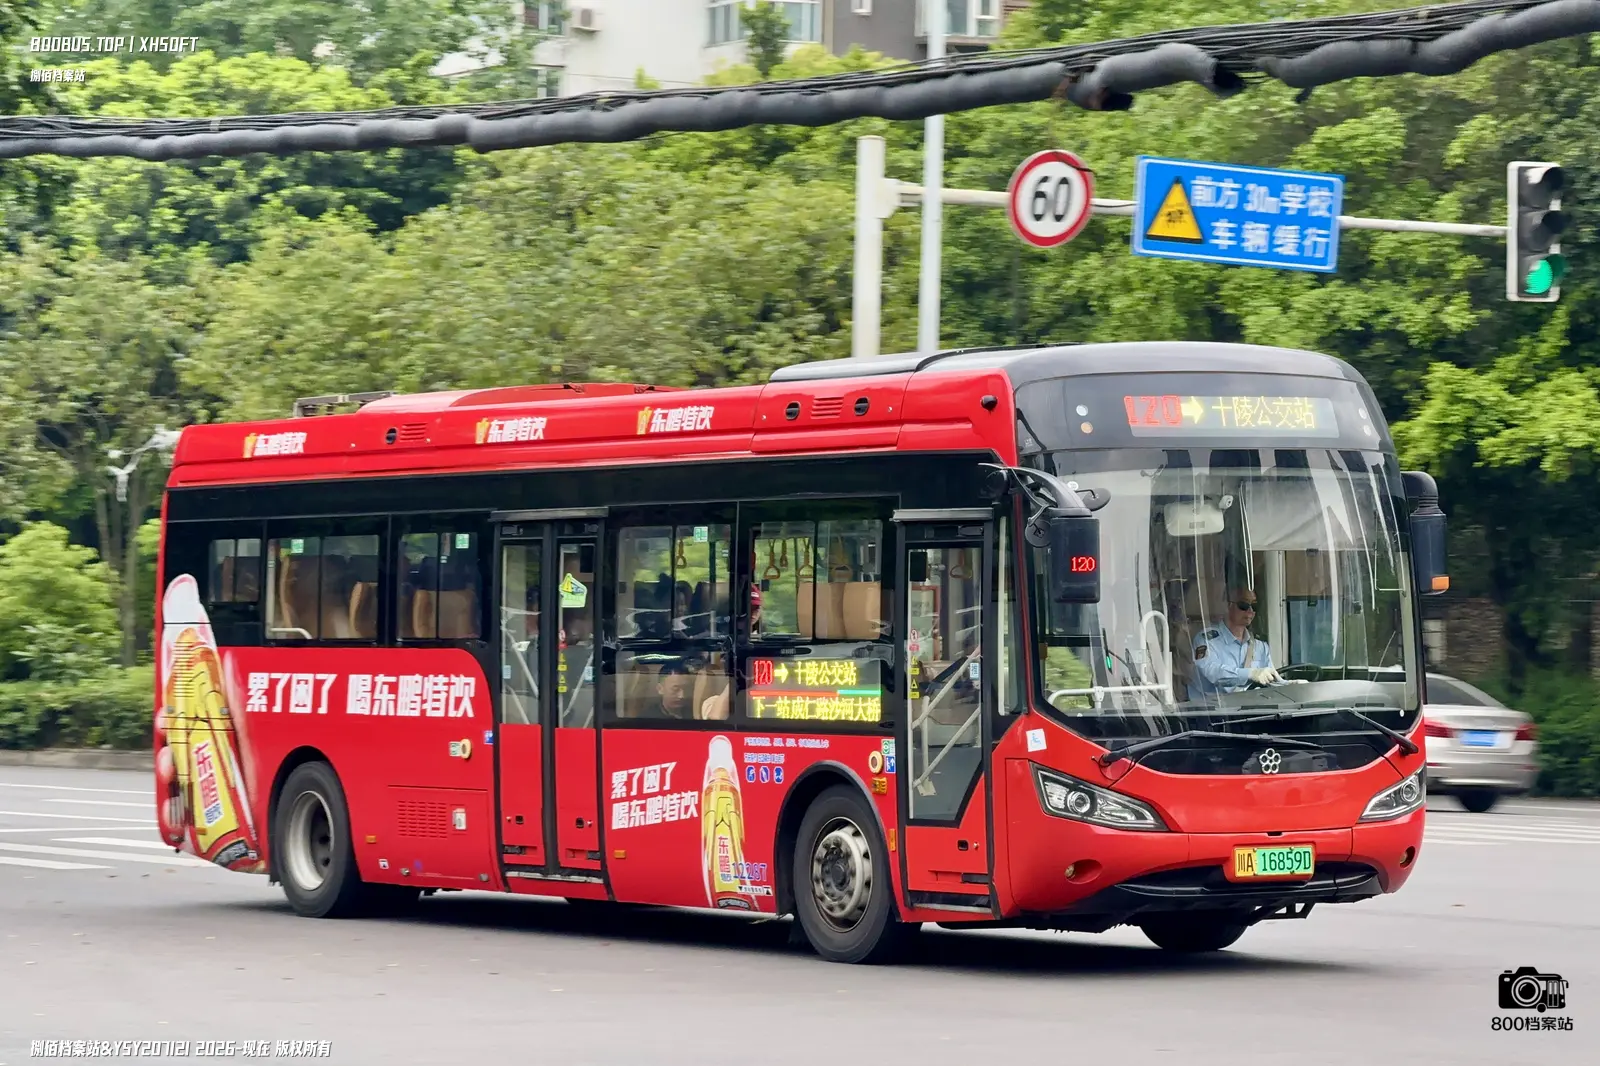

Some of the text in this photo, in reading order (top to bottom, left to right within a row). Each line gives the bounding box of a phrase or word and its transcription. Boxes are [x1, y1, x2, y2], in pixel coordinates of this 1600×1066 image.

[1032, 176, 1072, 222] 60
[1209, 219, 1330, 258] 车辆缓行
[650, 406, 715, 433] 东鹏特饮
[1124, 395, 1183, 427] 120
[1211, 396, 1315, 429] 十陵公交站
[254, 431, 307, 456] 东鹏特饮
[487, 416, 547, 444] 东鹏特饮
[1070, 556, 1096, 573] 120
[753, 660, 773, 685] 120
[795, 660, 857, 686] 十陵公交站
[246, 672, 477, 719] 累了困了 喝东鹏特饮
[610, 762, 677, 800] 累了困了
[611, 791, 699, 830] 喝东鹏特饮
[732, 862, 768, 882] 12287
